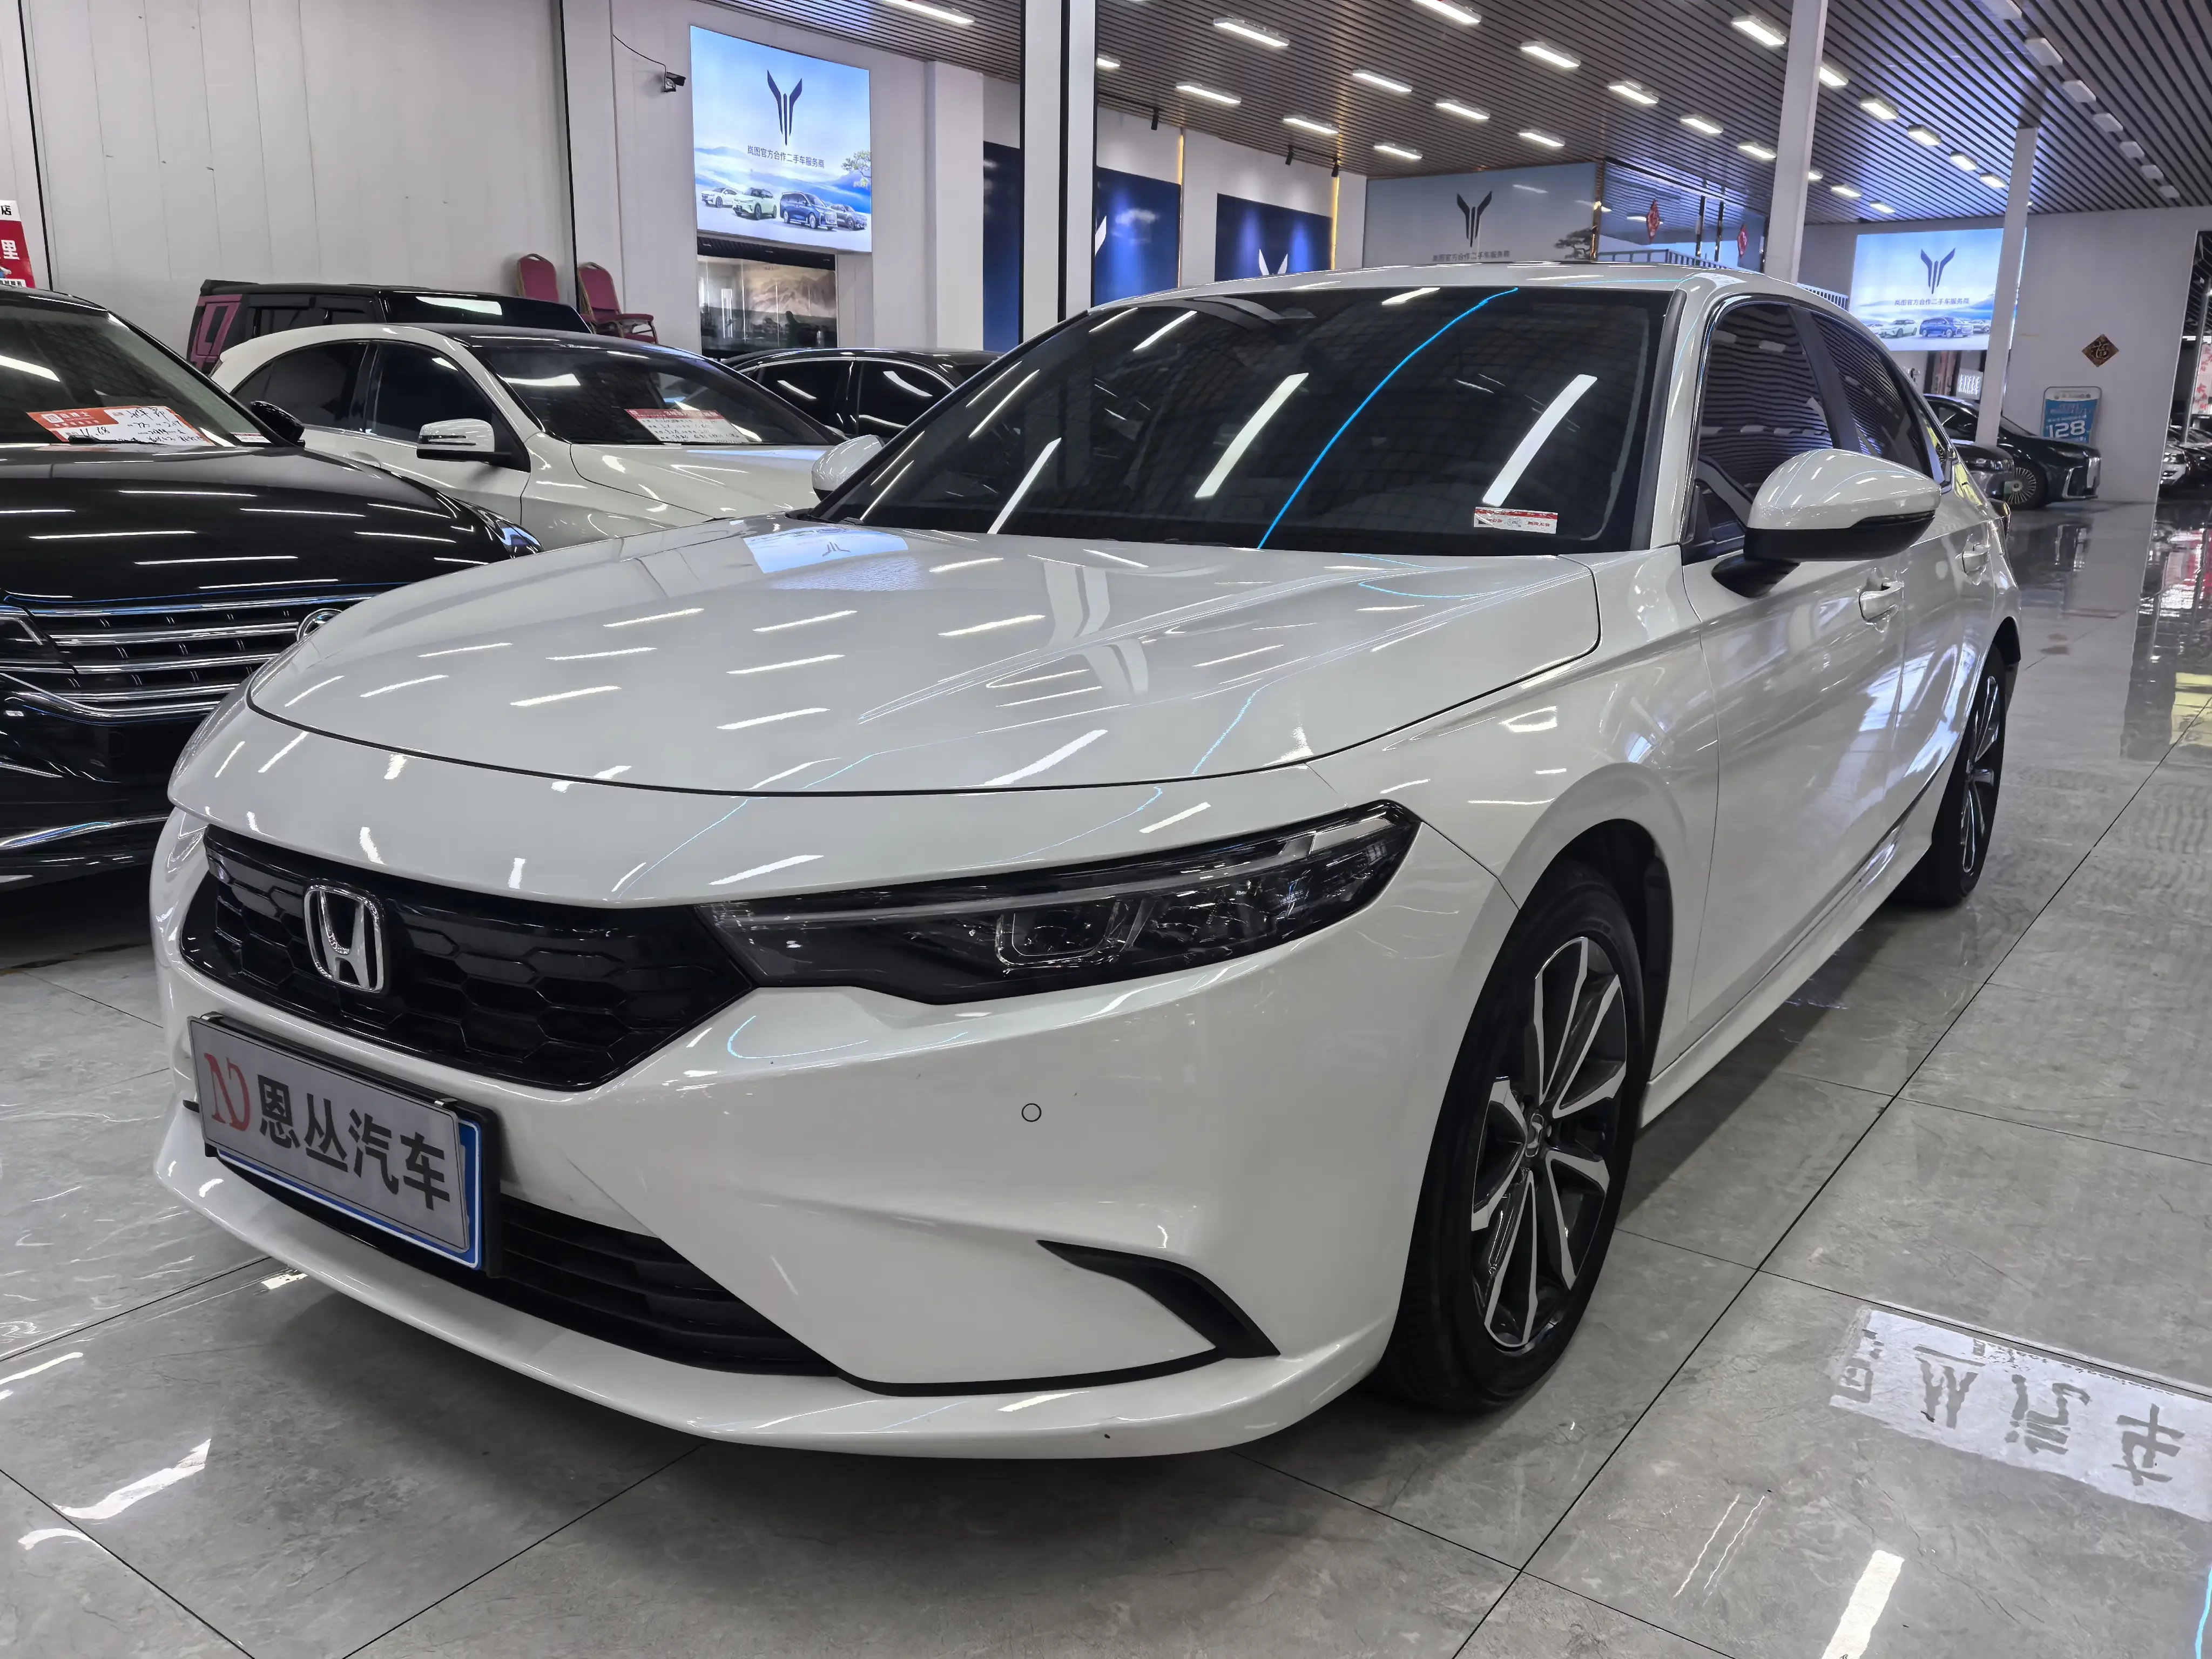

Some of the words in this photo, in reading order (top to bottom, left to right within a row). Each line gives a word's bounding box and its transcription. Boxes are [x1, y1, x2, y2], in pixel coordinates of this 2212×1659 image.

[747, 145, 825, 168] 岚图官方合作二手车服务商
[1, 205, 12, 215] 店
[1, 239, 20, 260] 里
[257, 1074, 450, 1211] 恩丛汽车
